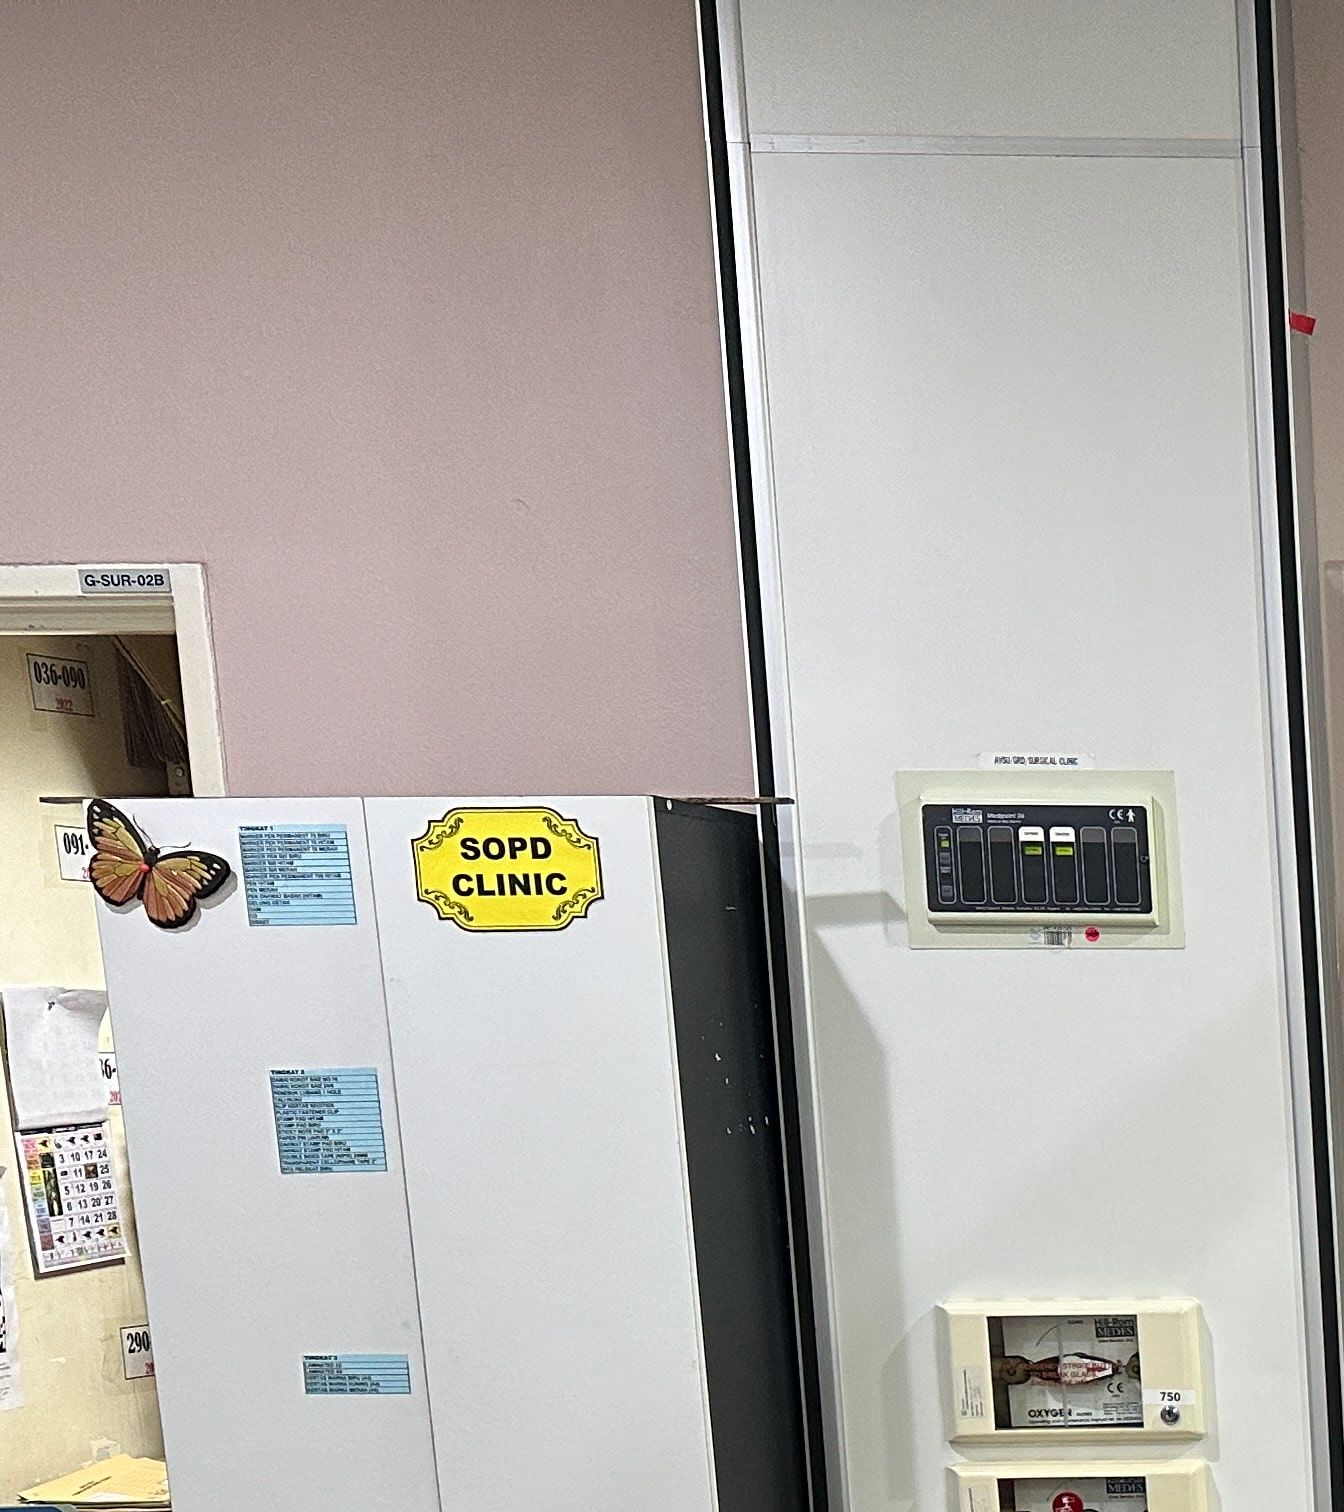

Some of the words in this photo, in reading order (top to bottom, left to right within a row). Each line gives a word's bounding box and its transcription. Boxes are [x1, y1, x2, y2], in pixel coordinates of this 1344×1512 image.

[85, 574, 164, 586] G-SUR-02B
[33, 661, 85, 689] 036-090
[460, 837, 551, 860] SOPD
[453, 873, 567, 896] CLINIC
[1160, 1392, 1181, 1402] 750
